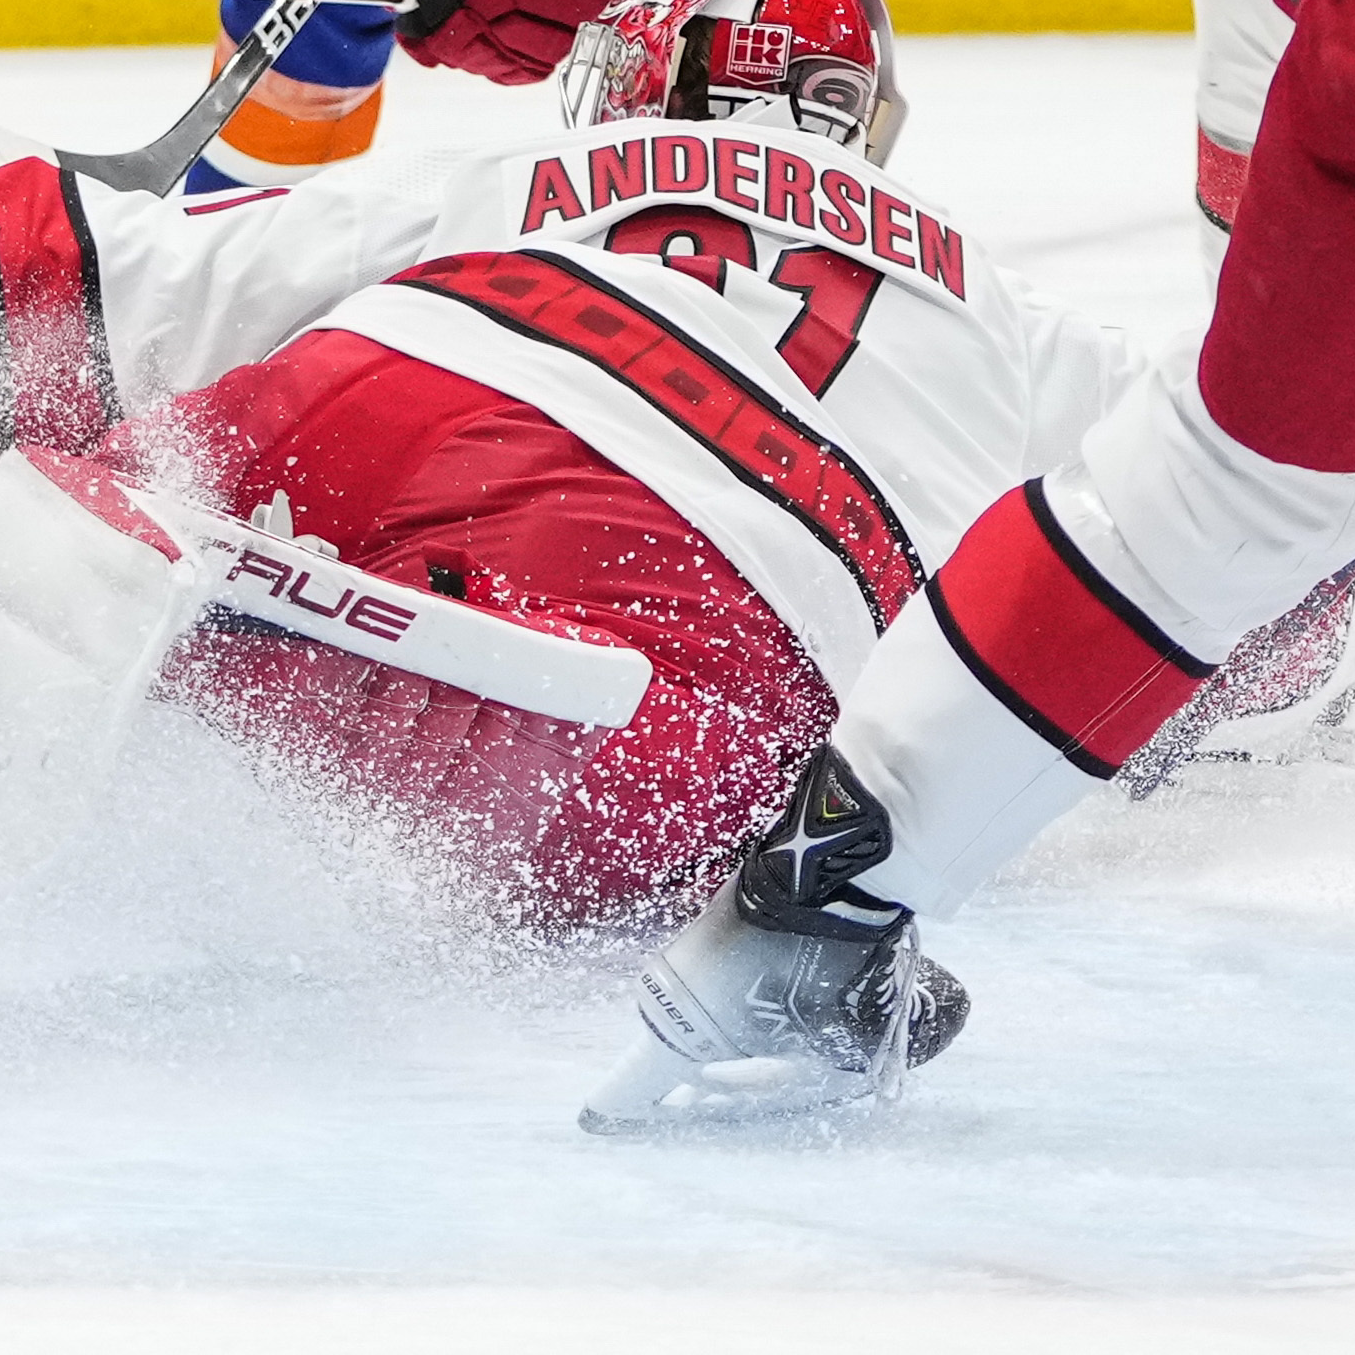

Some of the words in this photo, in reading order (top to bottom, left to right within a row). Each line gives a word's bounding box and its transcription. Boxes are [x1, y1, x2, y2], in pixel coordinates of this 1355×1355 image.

[730, 64, 784, 77] HERNING
[521, 135, 966, 302] ANDERSEN
[223, 544, 417, 643] RUE
[640, 973, 695, 1035] BAUER
